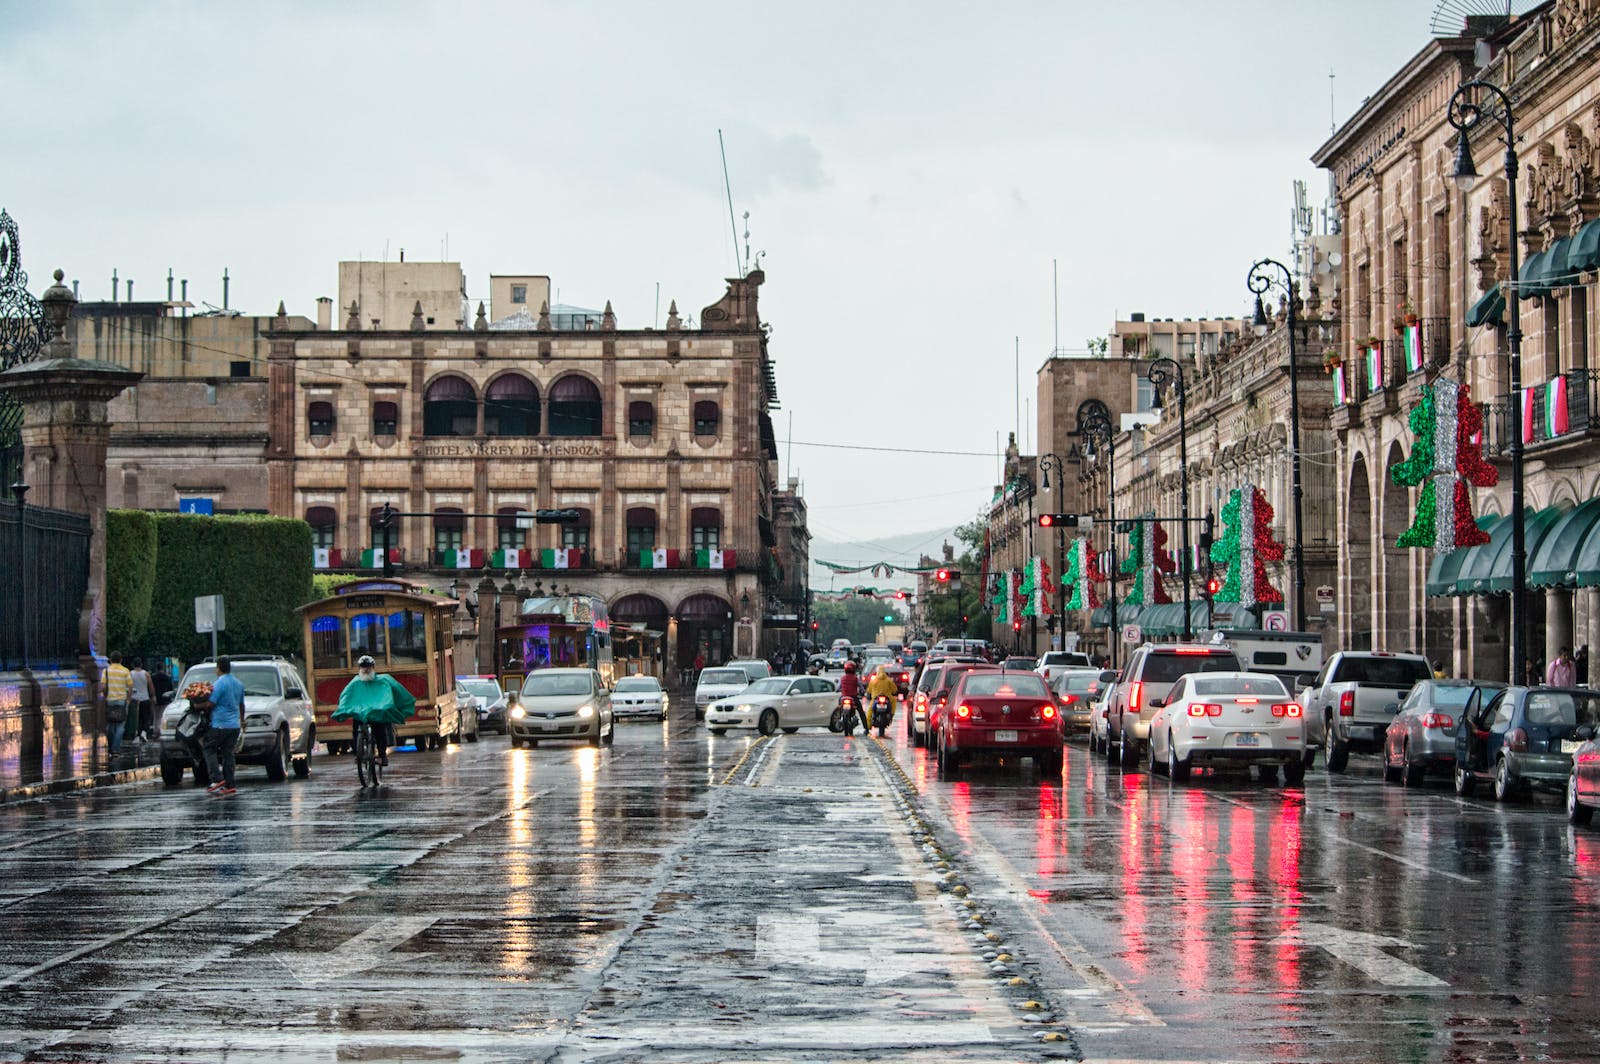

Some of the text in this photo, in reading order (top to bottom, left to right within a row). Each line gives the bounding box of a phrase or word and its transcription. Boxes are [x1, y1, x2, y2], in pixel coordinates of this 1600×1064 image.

[425, 446, 600, 456] HOTEL VIRREY DE MENDOZA
